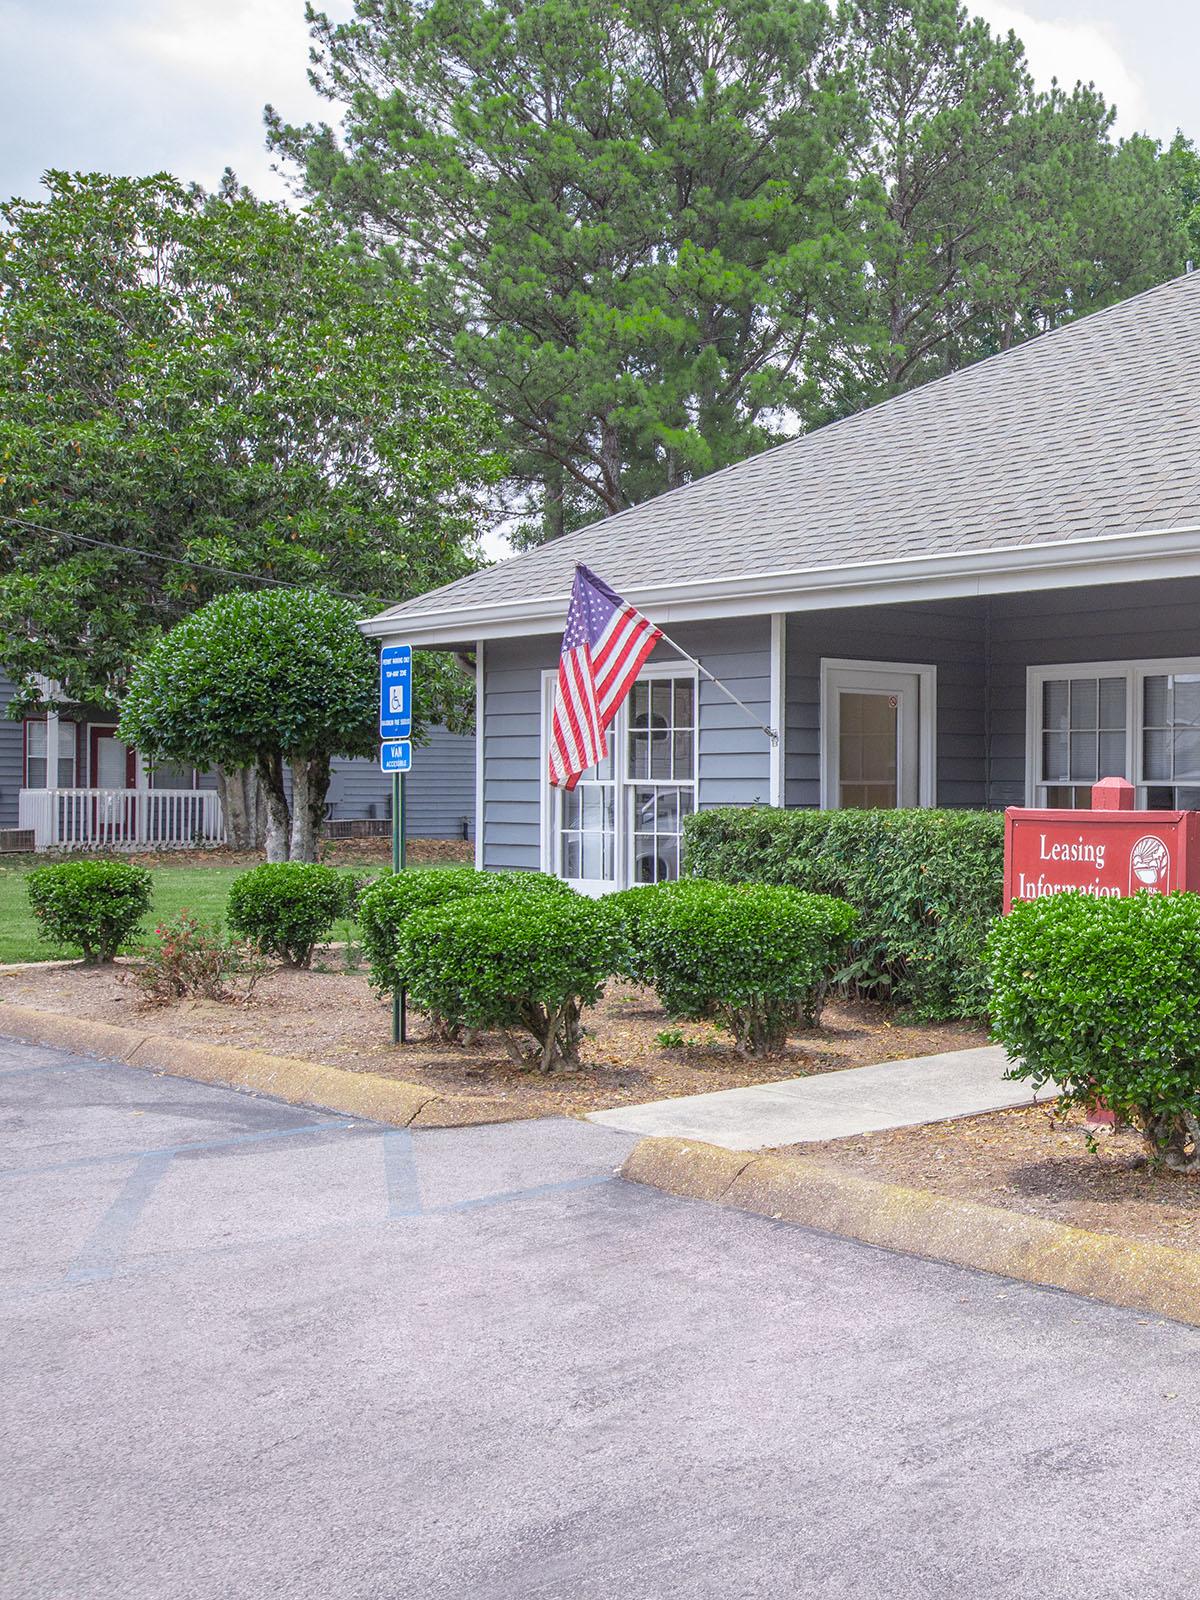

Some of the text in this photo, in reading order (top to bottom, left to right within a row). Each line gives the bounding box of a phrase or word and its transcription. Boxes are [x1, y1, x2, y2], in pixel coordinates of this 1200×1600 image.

[390, 745, 403, 758] VAN
[1040, 834, 1106, 869] Leasing
[1019, 873, 1121, 900] Information
